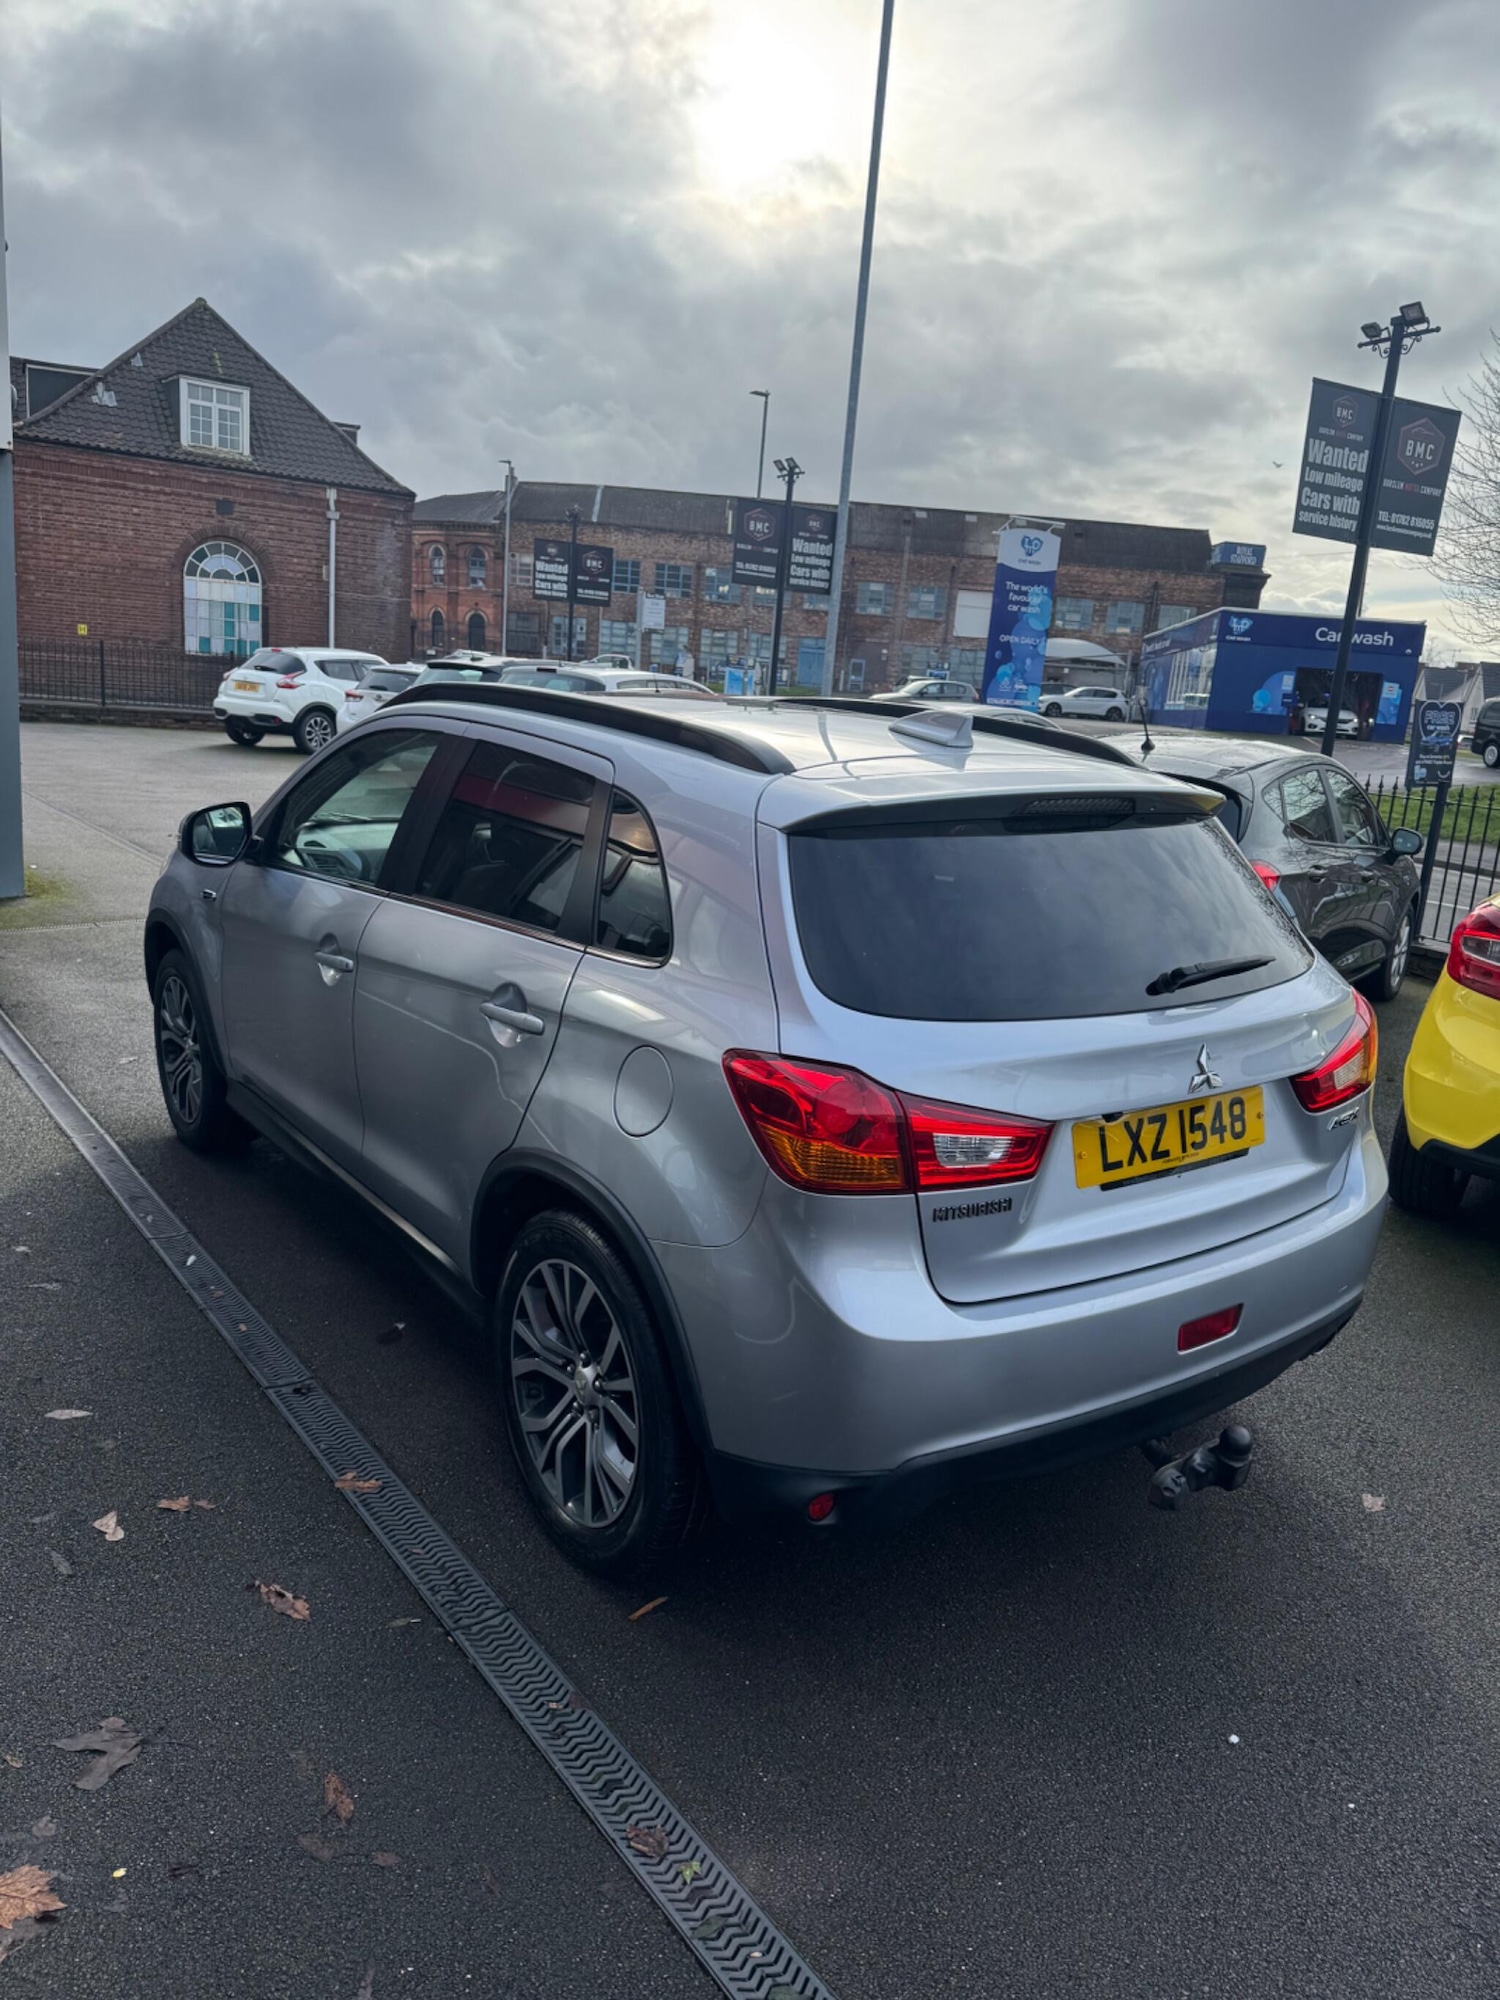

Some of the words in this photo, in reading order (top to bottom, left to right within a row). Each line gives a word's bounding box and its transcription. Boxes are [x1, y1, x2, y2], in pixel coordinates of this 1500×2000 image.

[1336, 408, 1353, 420] BMC
[1308, 438, 1369, 473] Wanted
[1406, 440, 1435, 461] BMC
[1305, 467, 1322, 484] Low
[1324, 472, 1364, 492] mileage
[1301, 487, 1331, 510] Cars
[1332, 494, 1360, 515] with
[749, 521, 770, 533] BMC
[1298, 510, 1328, 526] service
[1329, 514, 1358, 532] history
[792, 538, 833, 556] Wanted
[536, 560, 568, 574] Wanted
[791, 554, 804, 563] Low
[805, 556, 831, 567] mileage
[790, 565, 810, 577] Cars
[812, 568, 830, 580] with
[535, 580, 551, 589] Cars
[1006, 581, 1019, 590] The
[1000, 634, 1019, 643] OPEN
[1020, 636, 1041, 646] DAILY
[1351, 632, 1394, 646] wash
[1327, 1106, 1360, 1131] ASX
[1100, 1114, 1169, 1173] LXZ
[1178, 1096, 1247, 1154] 1548
[932, 1197, 1013, 1223] MITSUBISHI
